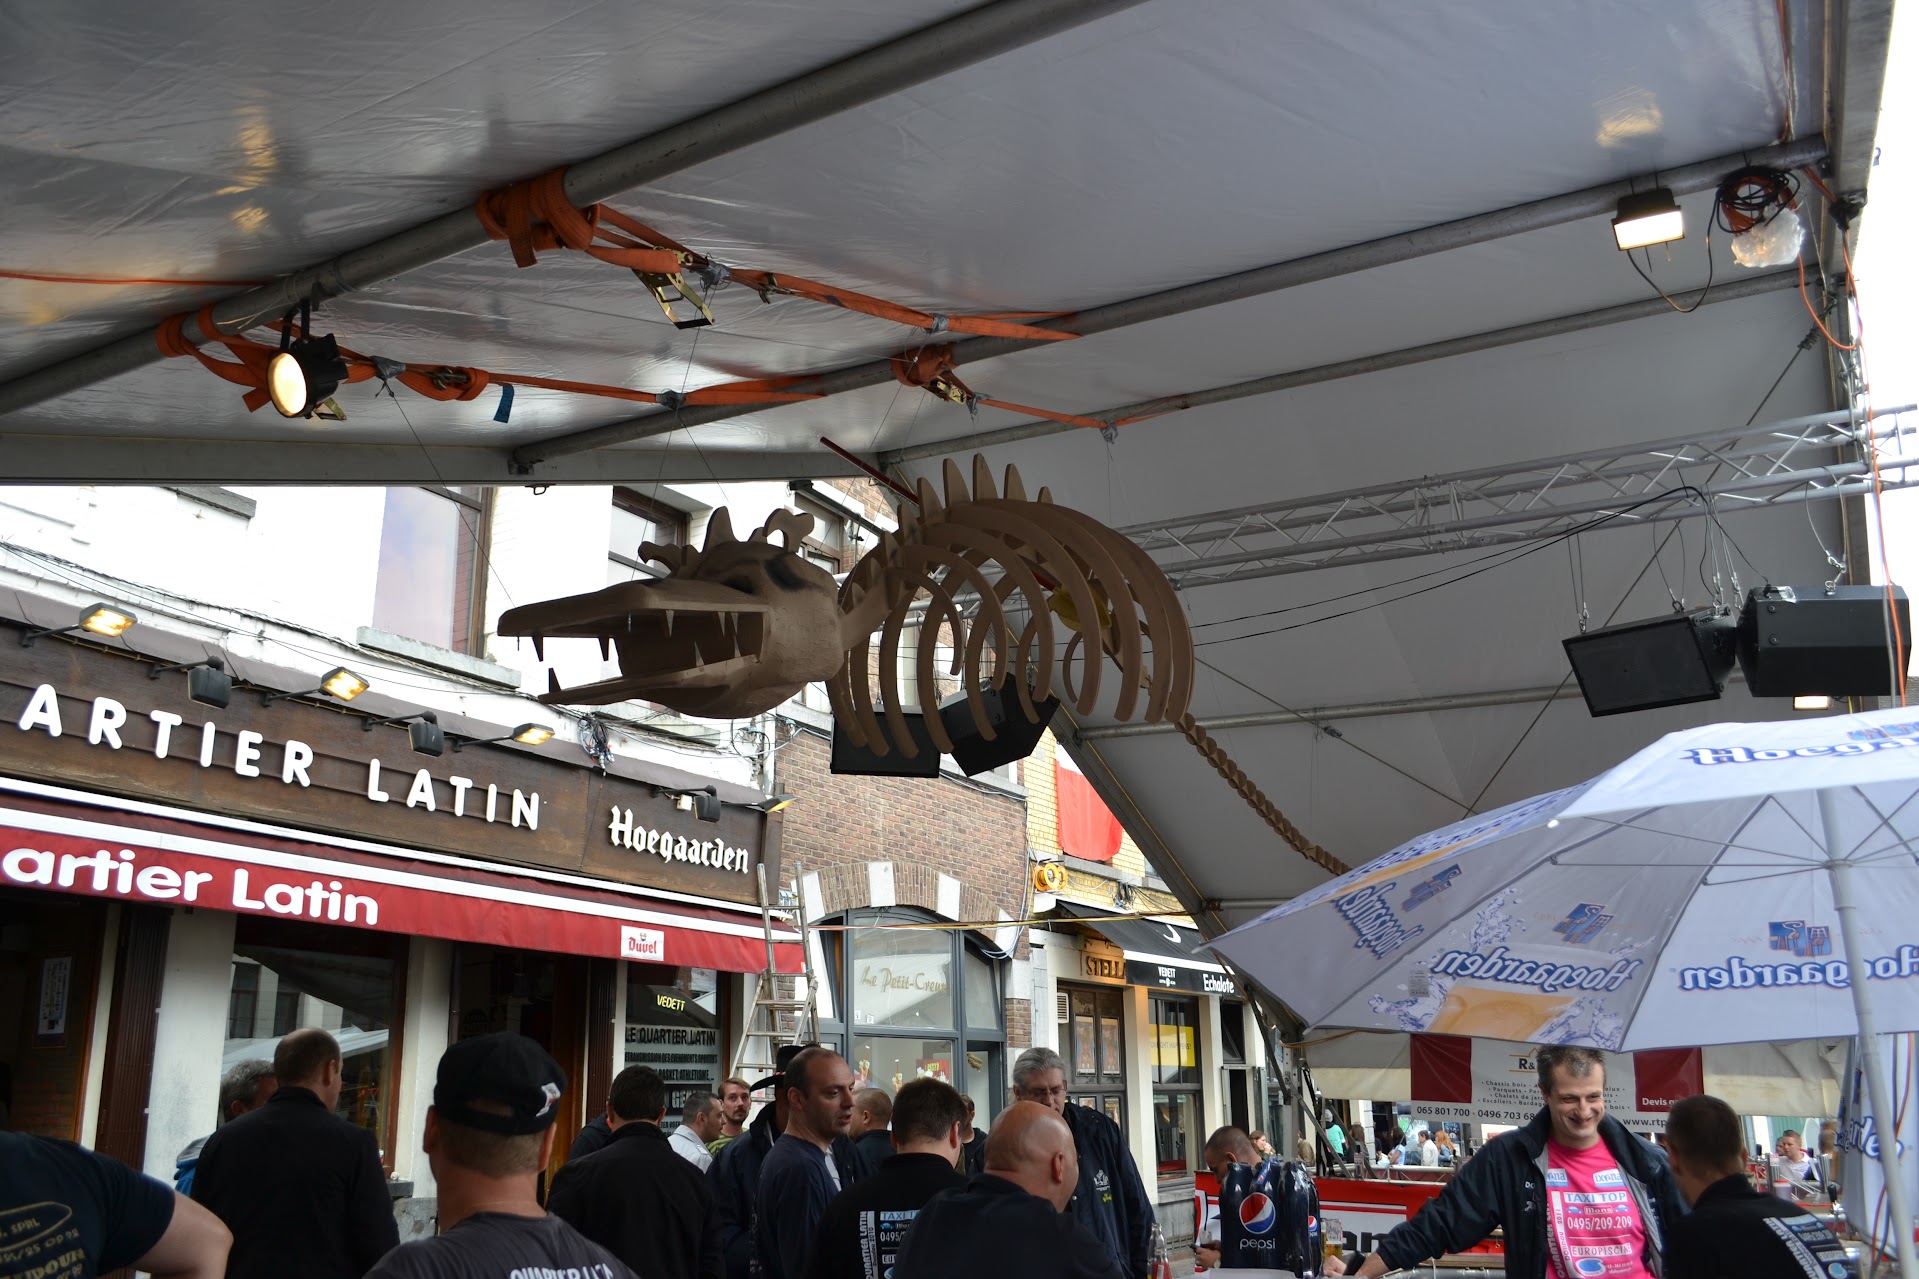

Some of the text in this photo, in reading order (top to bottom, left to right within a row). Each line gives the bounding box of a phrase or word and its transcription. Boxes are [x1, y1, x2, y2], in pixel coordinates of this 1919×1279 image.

[18, 683, 540, 831] ARTIER LATIN
[607, 804, 749, 875] Hoegaarden
[2, 847, 379, 926] artier Latin
[628, 936, 657, 955] Duvel
[1157, 966, 1176, 978] VEDETT
[1202, 973, 1235, 994] Echalote
[656, 994, 686, 1011] VEDETT
[639, 1027, 686, 1045] QUARTIER
[690, 1029, 716, 1046] LATIN
[1493, 1087, 1522, 1095] Parquets
[1642, 1097, 1667, 1106] Devis
[1417, 1106, 1667, 1128] 065 801 700 0496 703 68 www.rtp
[1565, 1193, 1626, 1203] TAXI TOP
[859, 1210, 868, 1236] LATIN
[882, 1212, 906, 1220] TAXI
[1567, 1215, 1632, 1231] 0495/209.209
[880, 1231, 906, 1242] 0495/
[1239, 1237, 1276, 1250] pepsi
[884, 1255, 897, 1263] EU
